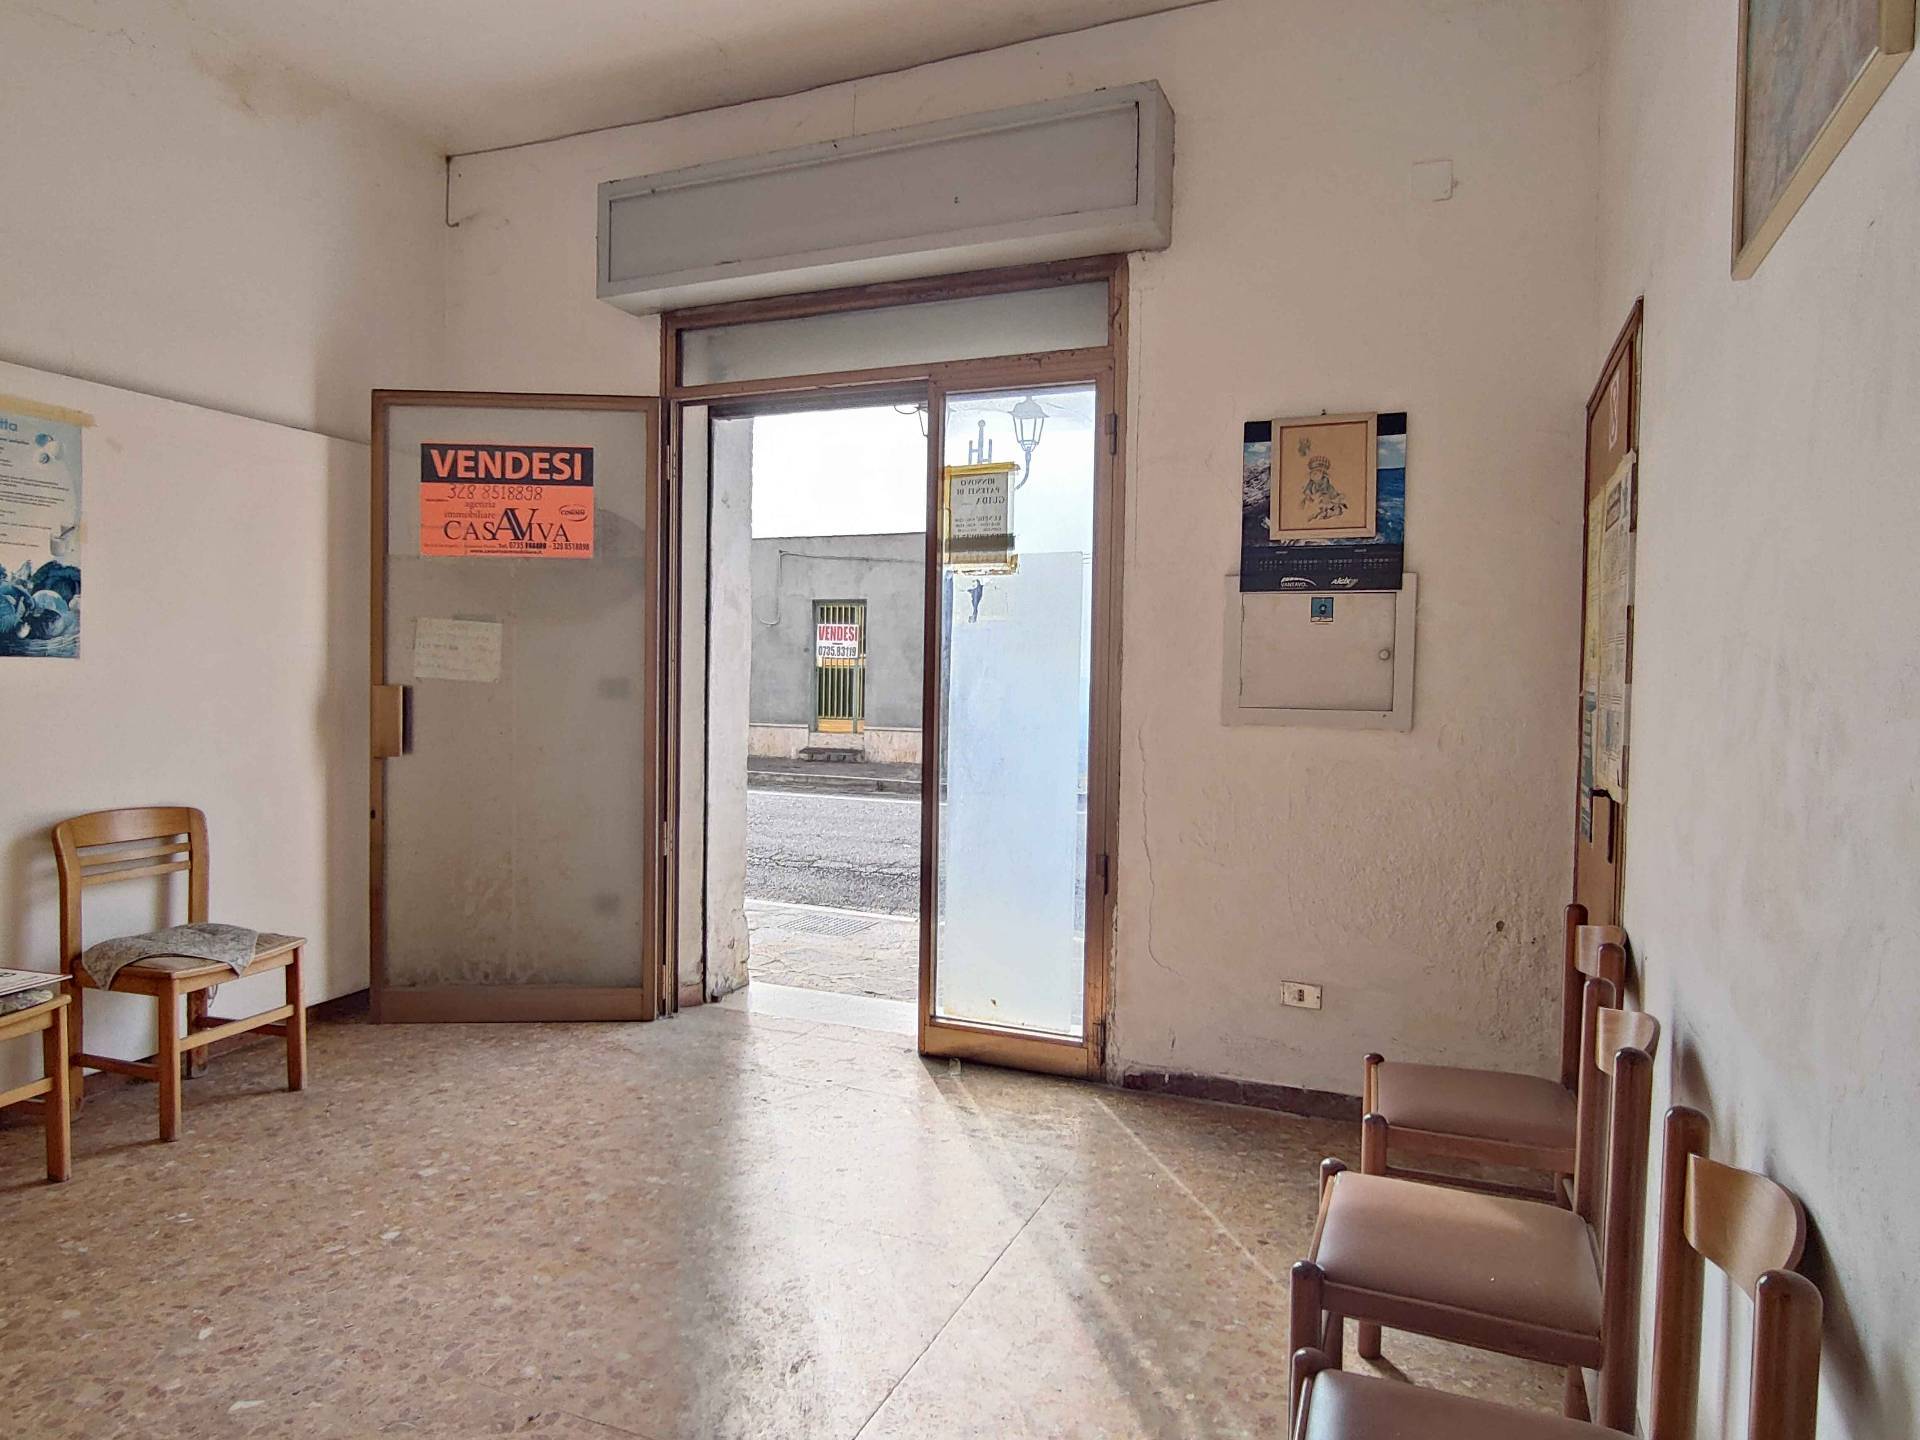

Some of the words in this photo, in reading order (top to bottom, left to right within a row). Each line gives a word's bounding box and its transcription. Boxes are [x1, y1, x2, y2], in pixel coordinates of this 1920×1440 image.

[430, 449, 582, 481] VENDESI
[447, 484, 476, 500] 328
[481, 485, 543, 501] 8518898
[464, 501, 496, 511] agenzia
[444, 511, 496, 520] immobiliare
[818, 626, 857, 641] VENDESI
